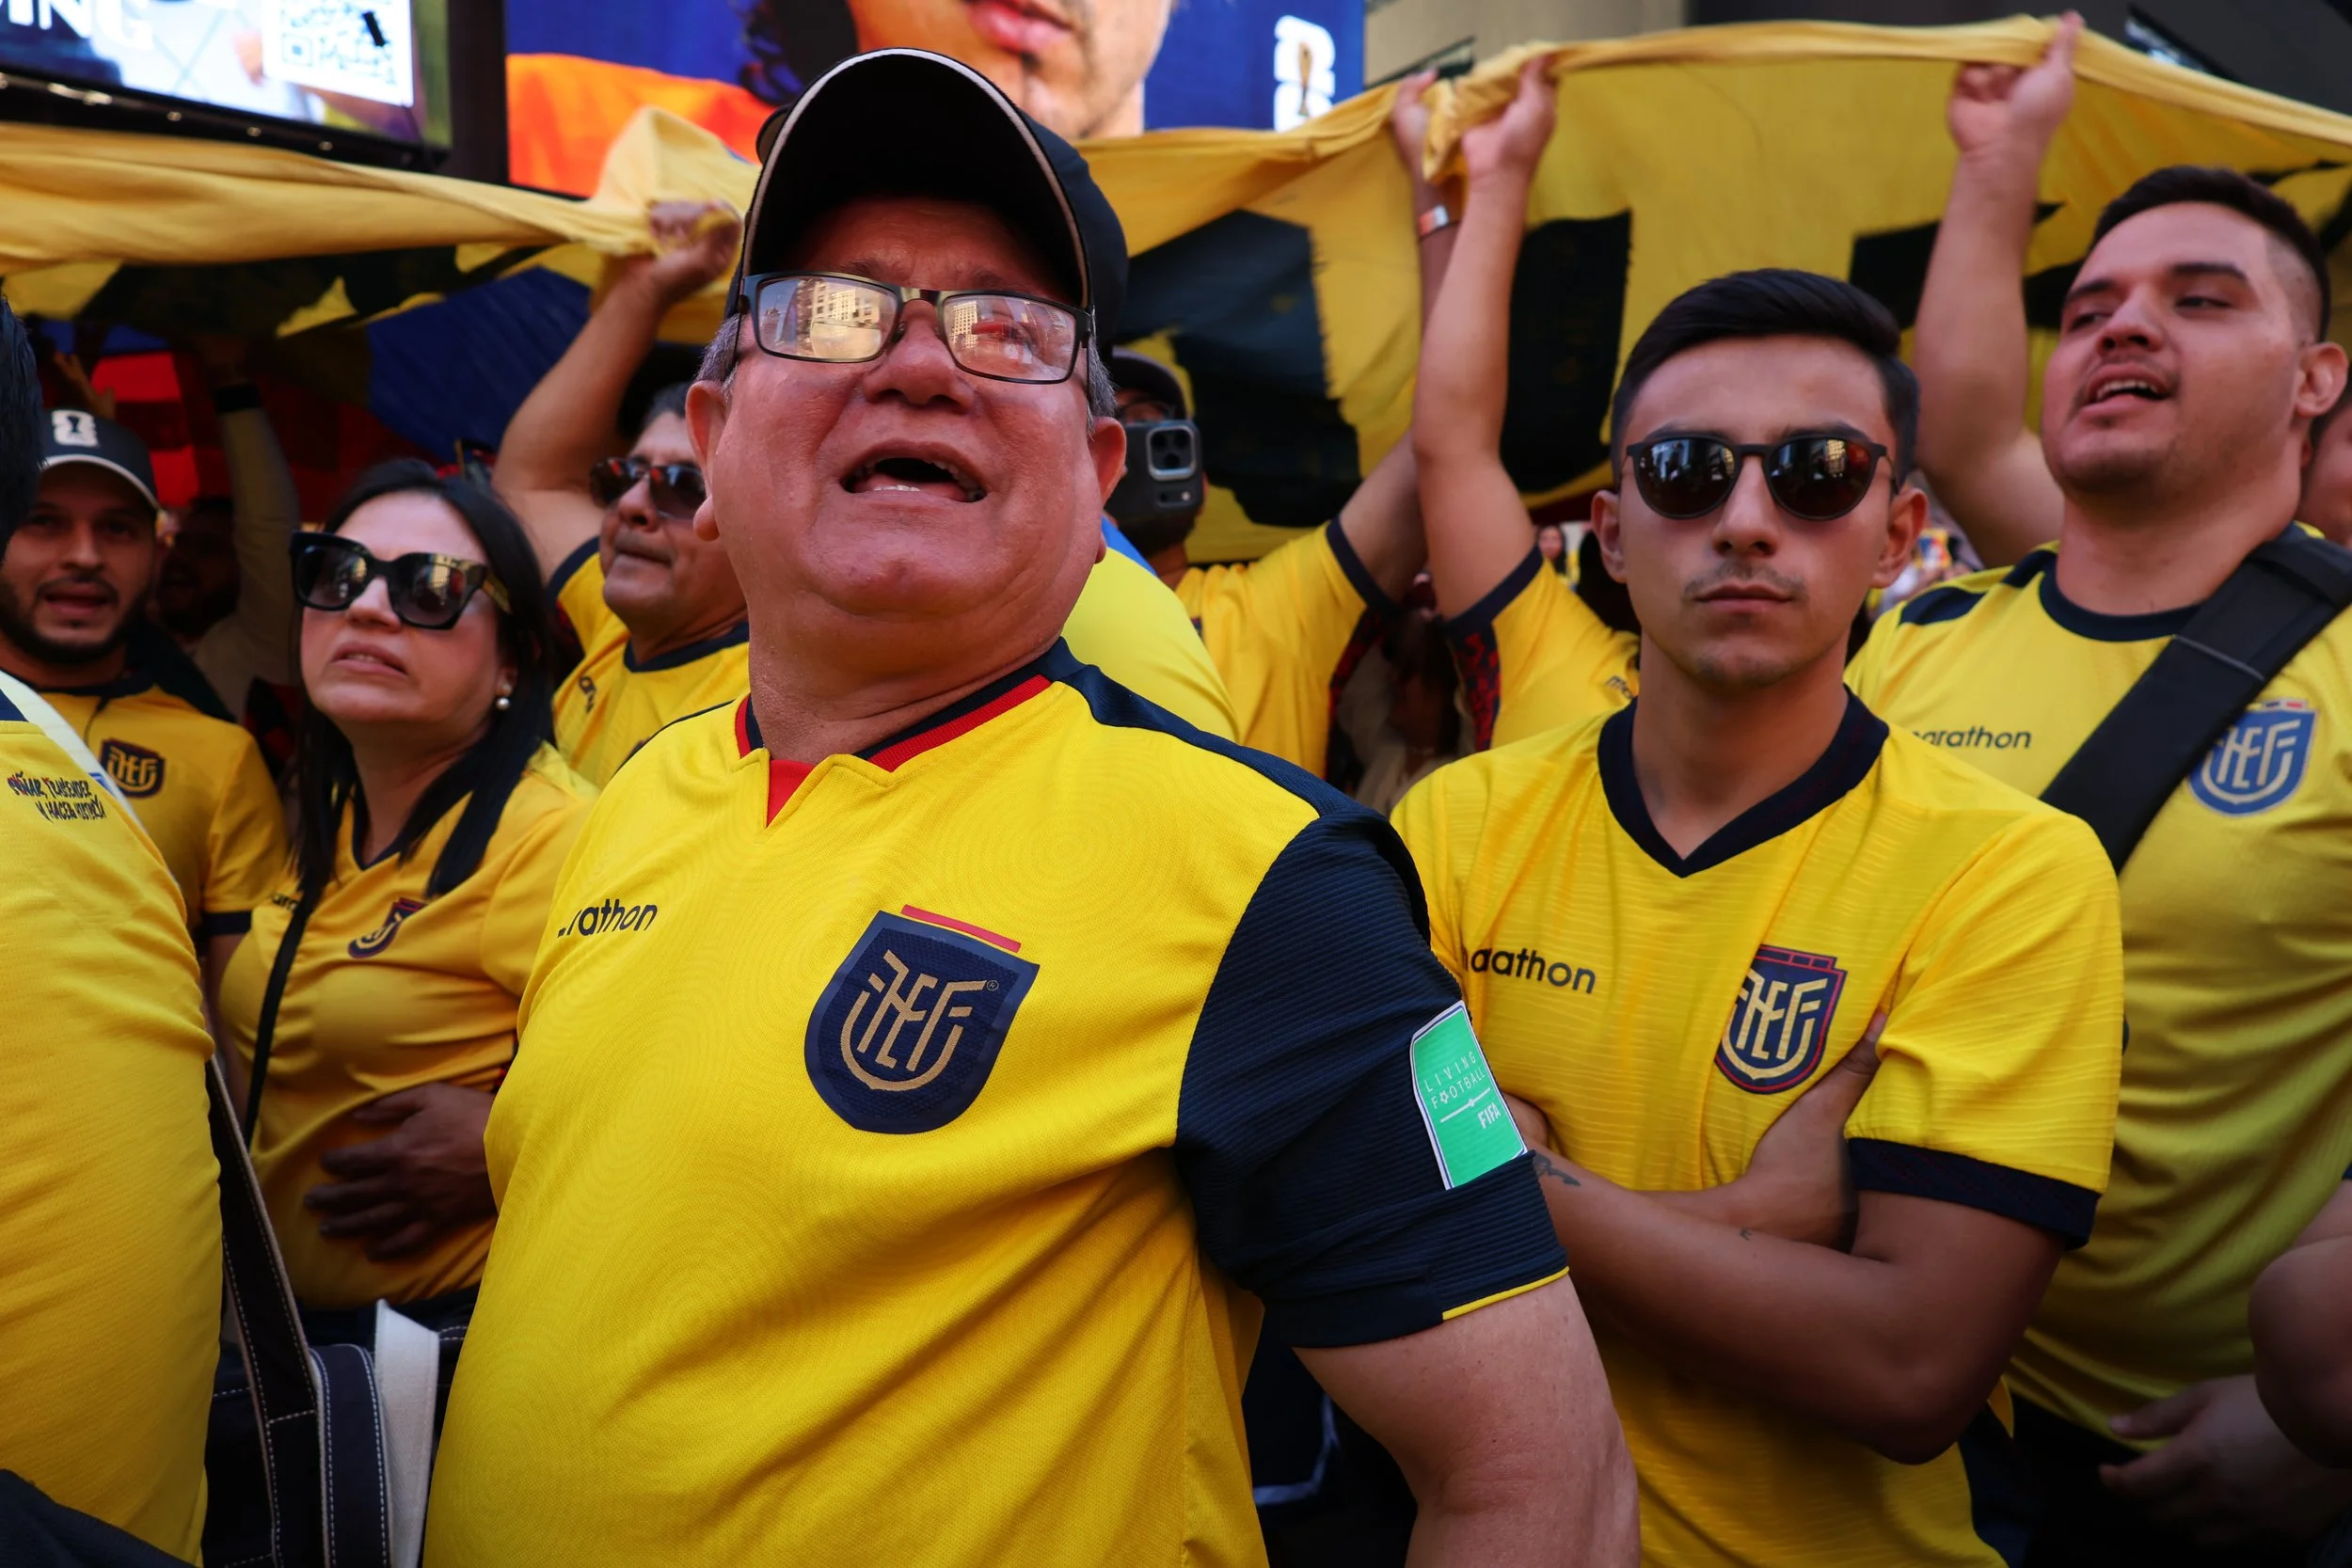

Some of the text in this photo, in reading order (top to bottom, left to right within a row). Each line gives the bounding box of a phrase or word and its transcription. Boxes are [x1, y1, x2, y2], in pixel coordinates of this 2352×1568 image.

[0, 0, 153, 51] ING
[1424, 1051, 1476, 1093] LIVING
[1477, 1102, 1502, 1129] FIFA
